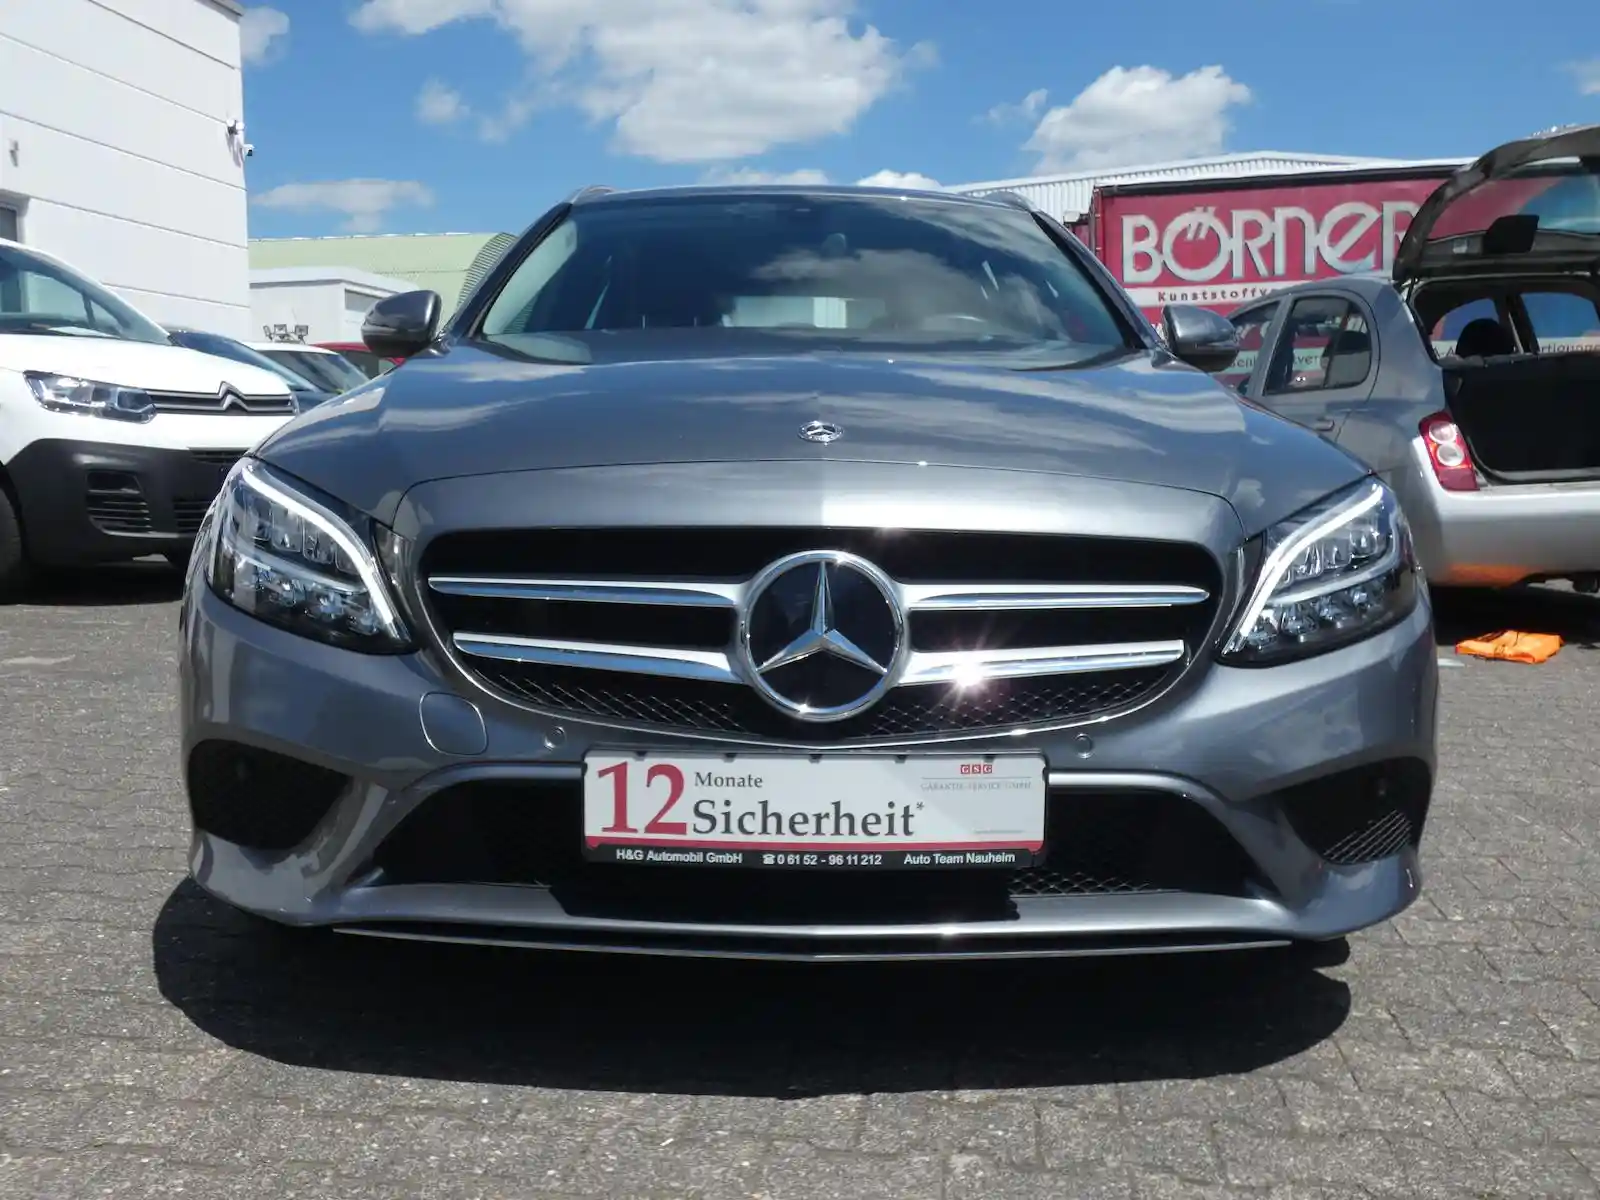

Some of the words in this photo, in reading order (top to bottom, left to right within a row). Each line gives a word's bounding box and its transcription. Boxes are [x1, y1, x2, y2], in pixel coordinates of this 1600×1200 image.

[1158, 288, 1269, 302] Kunststoffv
[960, 764, 992, 775] GSG
[694, 771, 763, 788] Monate
[597, 761, 688, 835] 12
[615, 848, 645, 861] H&G
[646, 850, 704, 863] Automobil
[705, 851, 743, 864] GmbH
[802, 854, 818, 865] 52
[828, 854, 845, 865] 96
[846, 854, 859, 865] 11
[860, 853, 882, 865] 212
[903, 853, 932, 865] Auto
[932, 852, 964, 864] Team
[965, 851, 1016, 864] Nauheim
